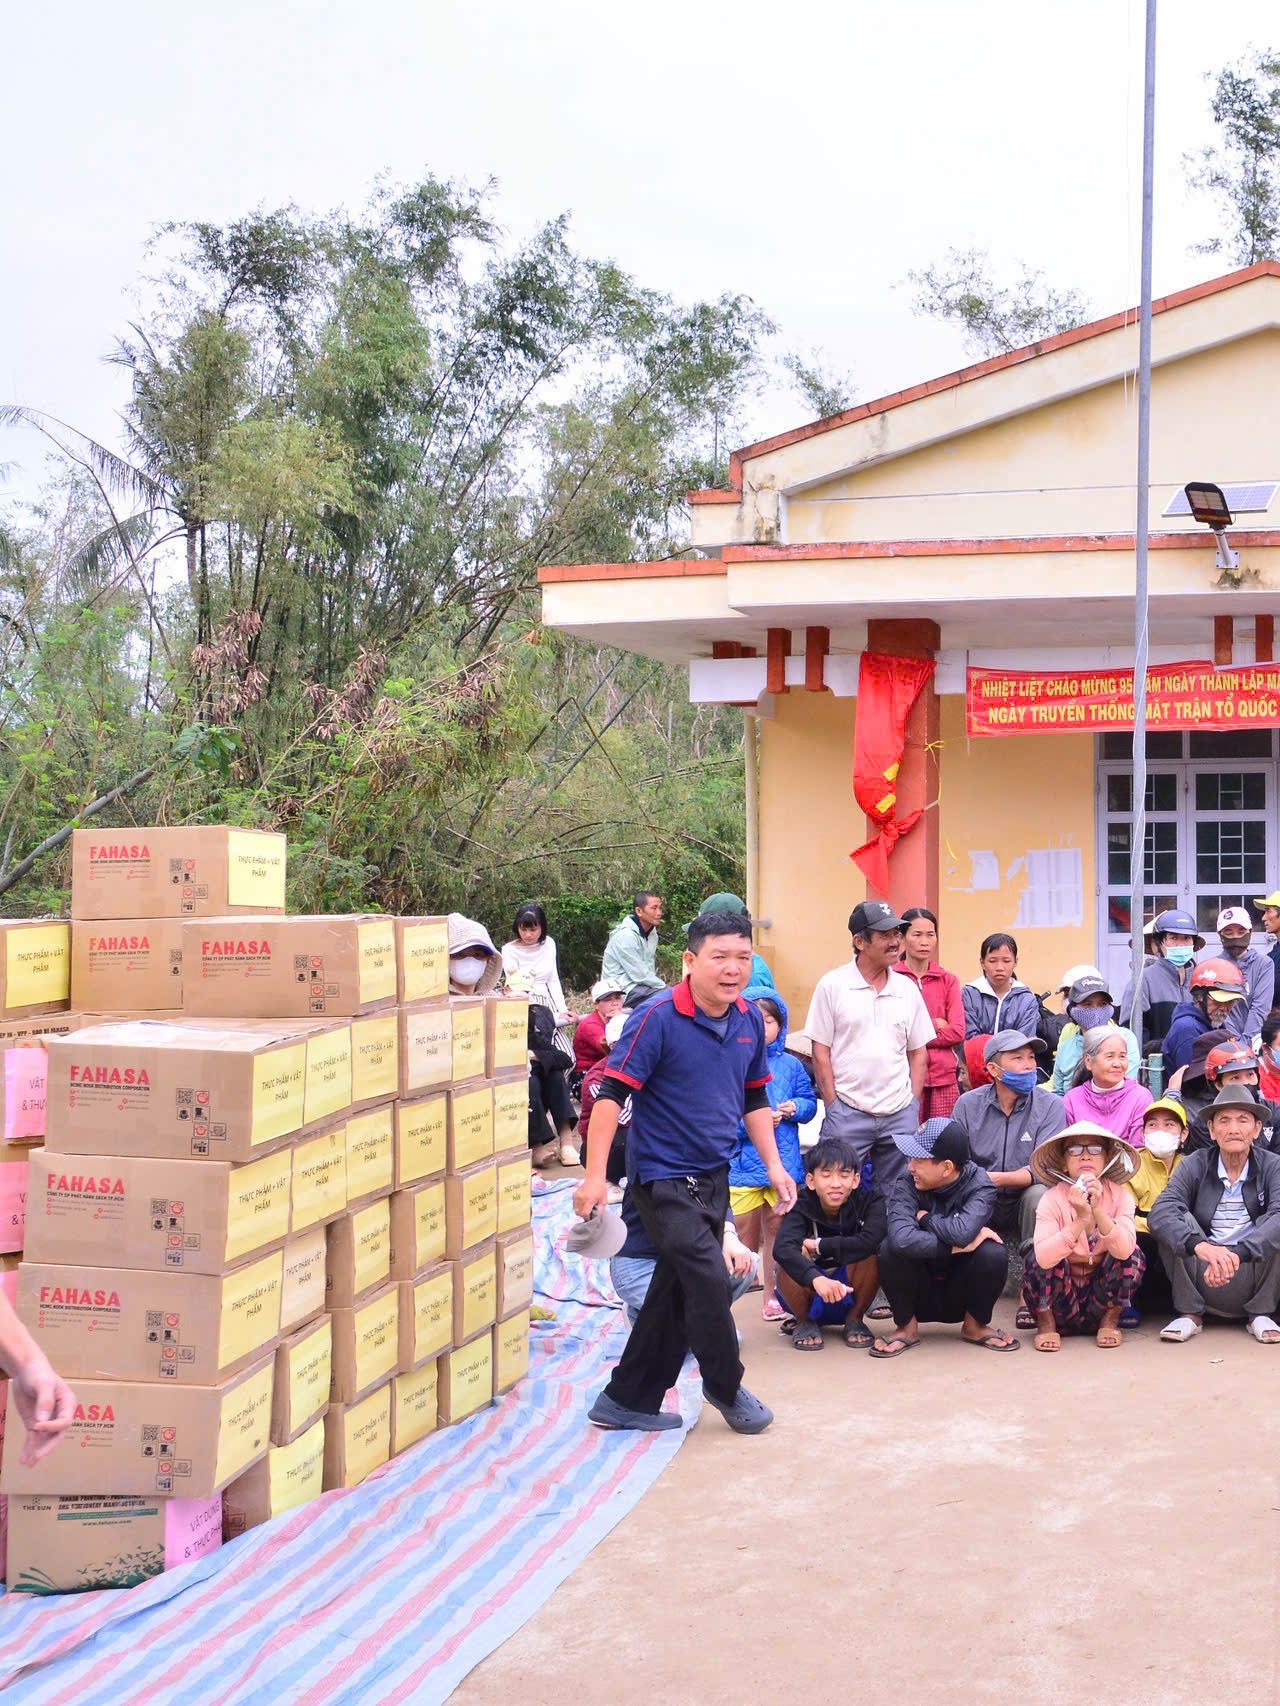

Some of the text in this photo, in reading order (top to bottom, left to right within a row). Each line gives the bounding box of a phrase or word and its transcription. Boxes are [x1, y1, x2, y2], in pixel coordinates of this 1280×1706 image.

[982, 677, 1016, 701] NHIỆT
[1019, 677, 1042, 700] LIỆT
[1046, 677, 1078, 696] CHÀO
[1082, 675, 1116, 695] MỪNG
[1120, 677, 1133, 693] 95
[1145, 673, 1161, 693] ĂM
[1164, 671, 1196, 692] NGÀY
[1200, 671, 1239, 691] THÀNH
[1242, 670, 1264, 694] LẬP
[989, 703, 1026, 724] NGÀY
[1031, 699, 1084, 723] TRUYỀN
[1089, 698, 1135, 721] THỐNG
[1145, 700, 1174, 723] MẶT
[1175, 698, 1211, 722] TRẬN
[1215, 692, 1234, 718] TỔ
[1238, 693, 1277, 717] QUỐC
[90, 845, 150, 859] FAHASA
[89, 935, 150, 950] FAHASA
[202, 941, 271, 955] FAHASA
[71, 1065, 150, 1085] FAHASA
[22, 1099, 47, 1111] & THỰ
[48, 1174, 125, 1194] FAHASA
[240, 1192, 254, 1204] THỰC
[256, 1183, 271, 1197] PHẨM
[276, 1177, 286, 1190] VẬT
[255, 1197, 270, 1213] PHẨM
[40, 1287, 120, 1306] FAHASA
[73, 1403, 115, 1421] ASA
